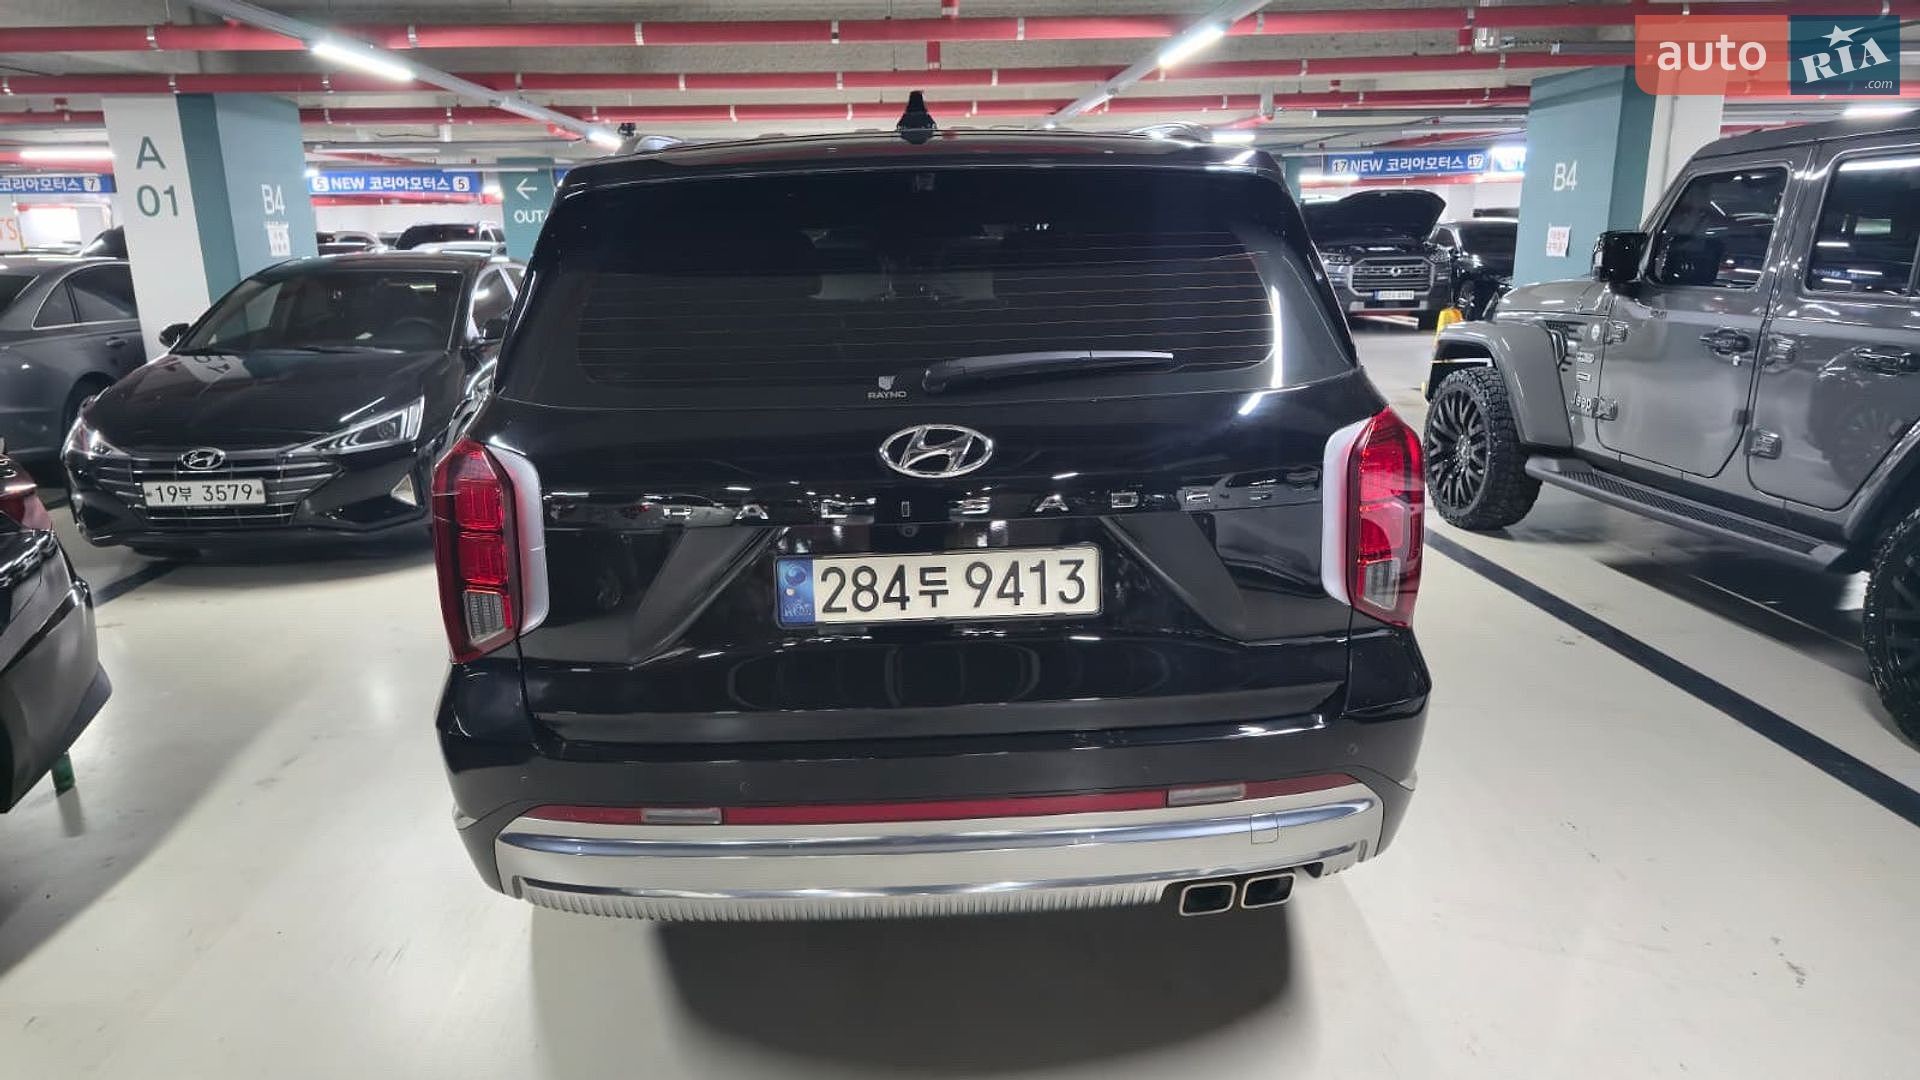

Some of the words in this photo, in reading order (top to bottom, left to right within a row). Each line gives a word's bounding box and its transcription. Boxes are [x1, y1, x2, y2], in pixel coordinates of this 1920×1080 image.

[136, 136, 166, 170] A
[1350, 159, 1384, 172] NEW
[1386, 156, 1464, 172] 코리아모터스
[331, 177, 364, 190] NEW
[369, 177, 450, 191] 코리아모터스
[1553, 161, 1578, 192] B4
[136, 185, 179, 217] 01
[261, 184, 286, 216] B4
[514, 209, 544, 223] OUT
[155, 485, 192, 503] 19부
[201, 483, 252, 502] 3579
[820, 564, 950, 614] 284두
[965, 558, 1085, 609] 9413
